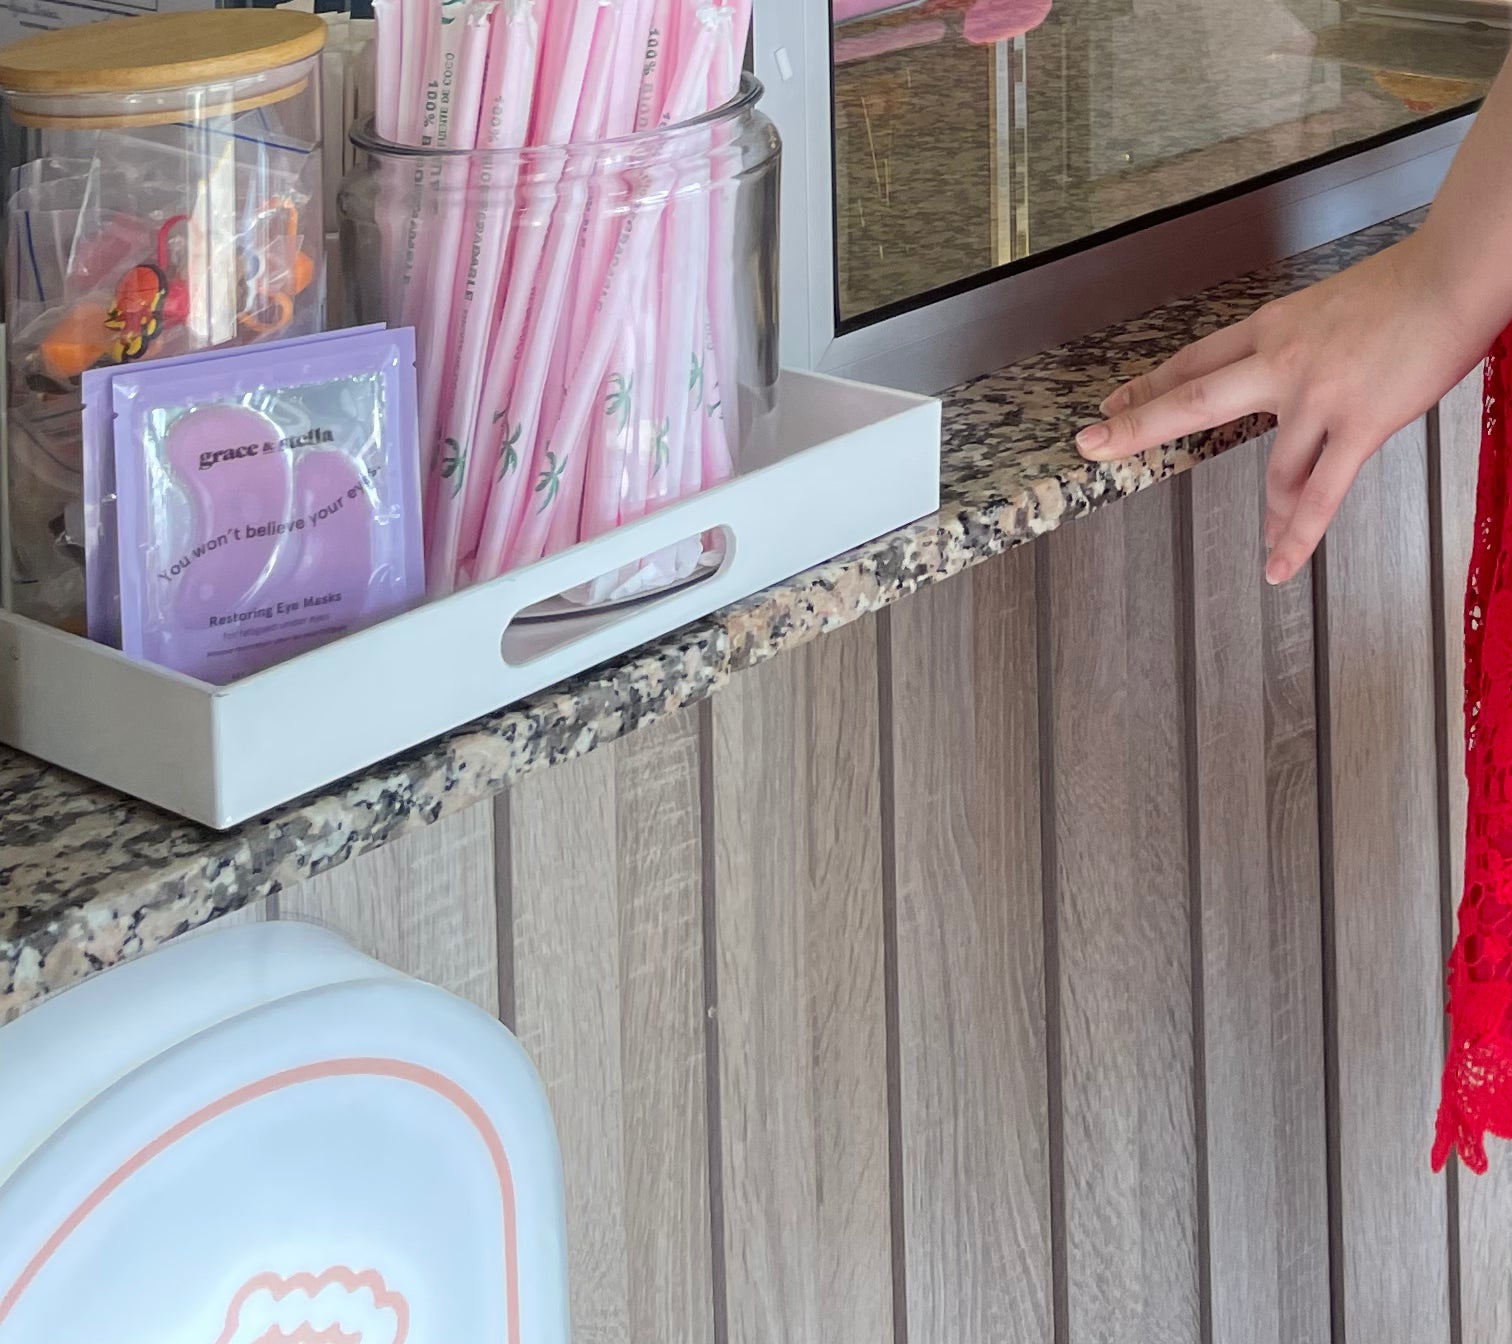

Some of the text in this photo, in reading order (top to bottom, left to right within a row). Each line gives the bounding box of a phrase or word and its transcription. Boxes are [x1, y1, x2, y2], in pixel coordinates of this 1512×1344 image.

[422, 79, 439, 128] 100%
[198, 443, 259, 471] grace
[157, 554, 192, 583] You
[192, 528, 241, 559] won't
[245, 518, 305, 539] believe
[308, 496, 344, 528] your
[209, 606, 273, 627] Restoring
[277, 601, 299, 615] Eye
[303, 591, 342, 608] Masks
